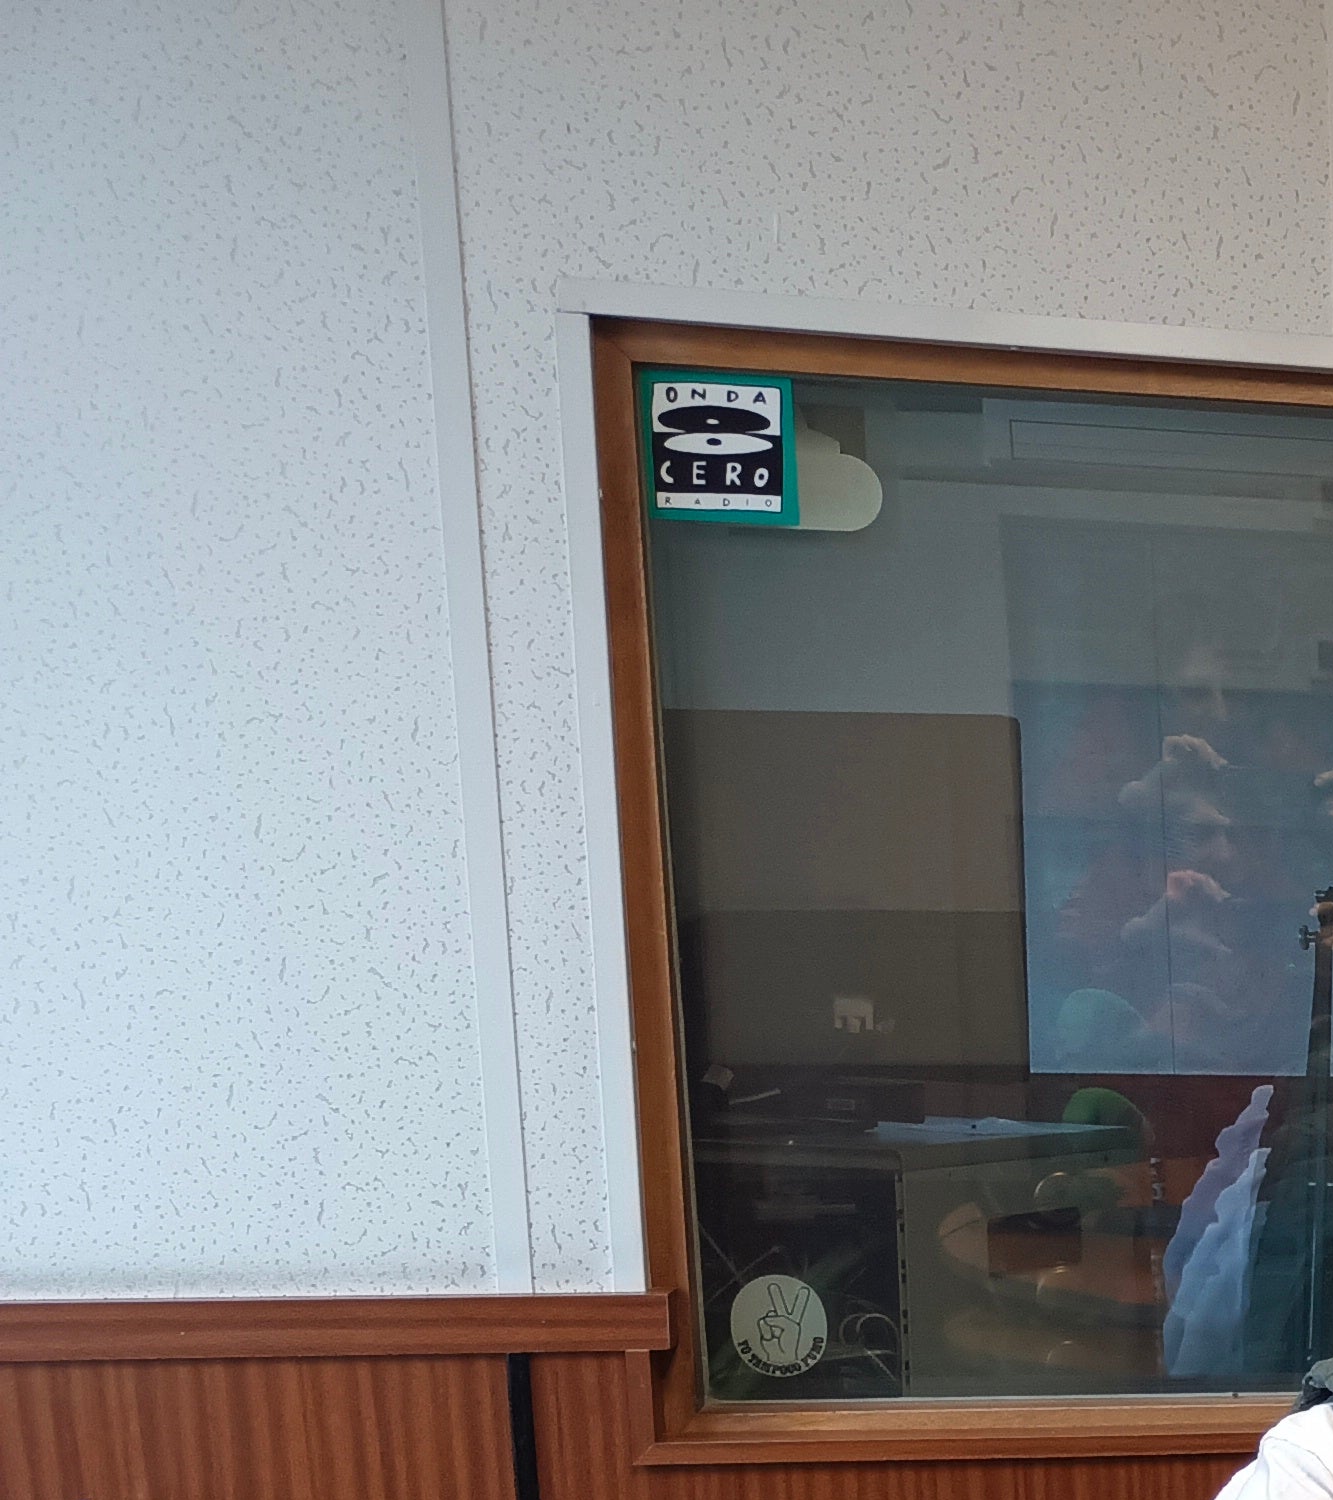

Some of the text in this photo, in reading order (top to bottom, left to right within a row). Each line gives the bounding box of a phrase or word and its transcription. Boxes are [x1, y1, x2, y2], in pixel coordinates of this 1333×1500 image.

[665, 385, 767, 404] ONDA
[660, 460, 769, 488] CERO
[664, 496, 772, 508] RADIO
